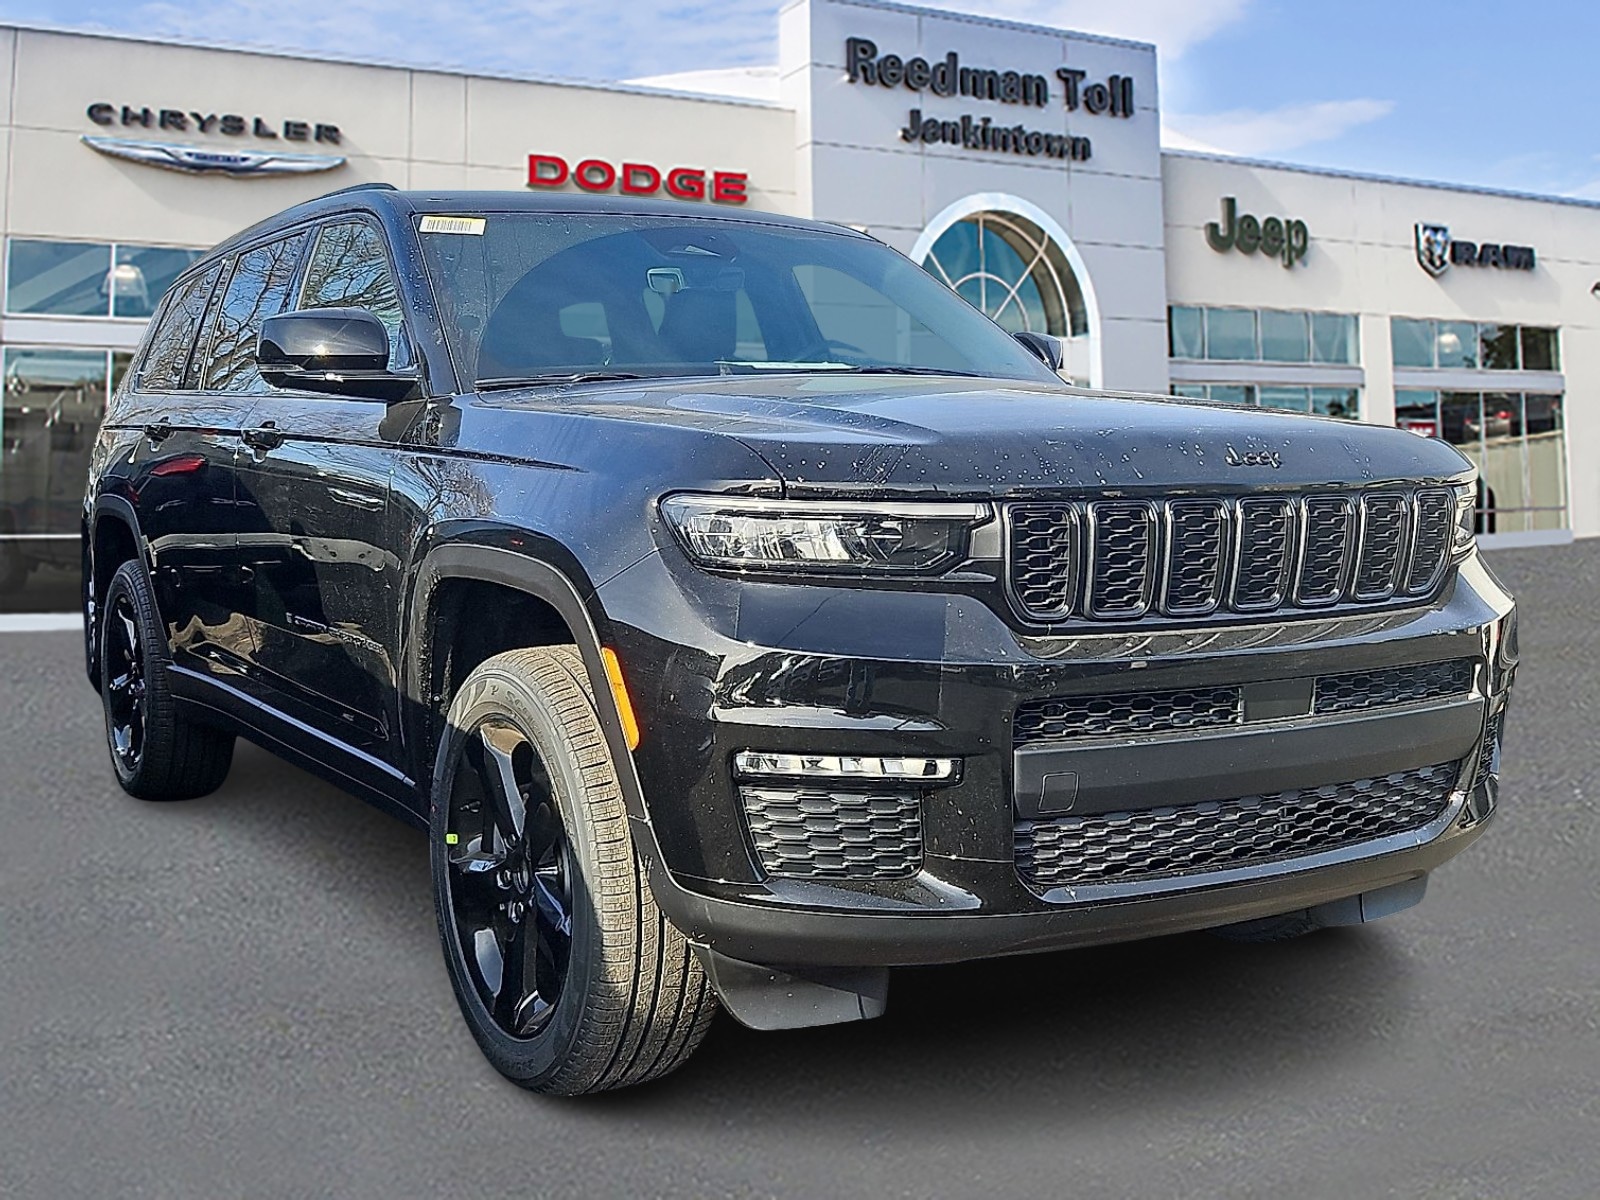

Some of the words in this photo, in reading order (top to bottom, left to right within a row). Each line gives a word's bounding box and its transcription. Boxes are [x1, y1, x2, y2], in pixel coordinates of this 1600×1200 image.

[845, 36, 1049, 107] Reedman
[1056, 67, 1134, 118] Toll
[86, 102, 341, 144] CHRYSLER
[900, 109, 1092, 161] Jenkintown
[527, 153, 748, 203] DODGE
[1205, 196, 1309, 269] Jeep
[1450, 240, 1536, 271] RAM
[1224, 442, 1282, 469] Jeep
